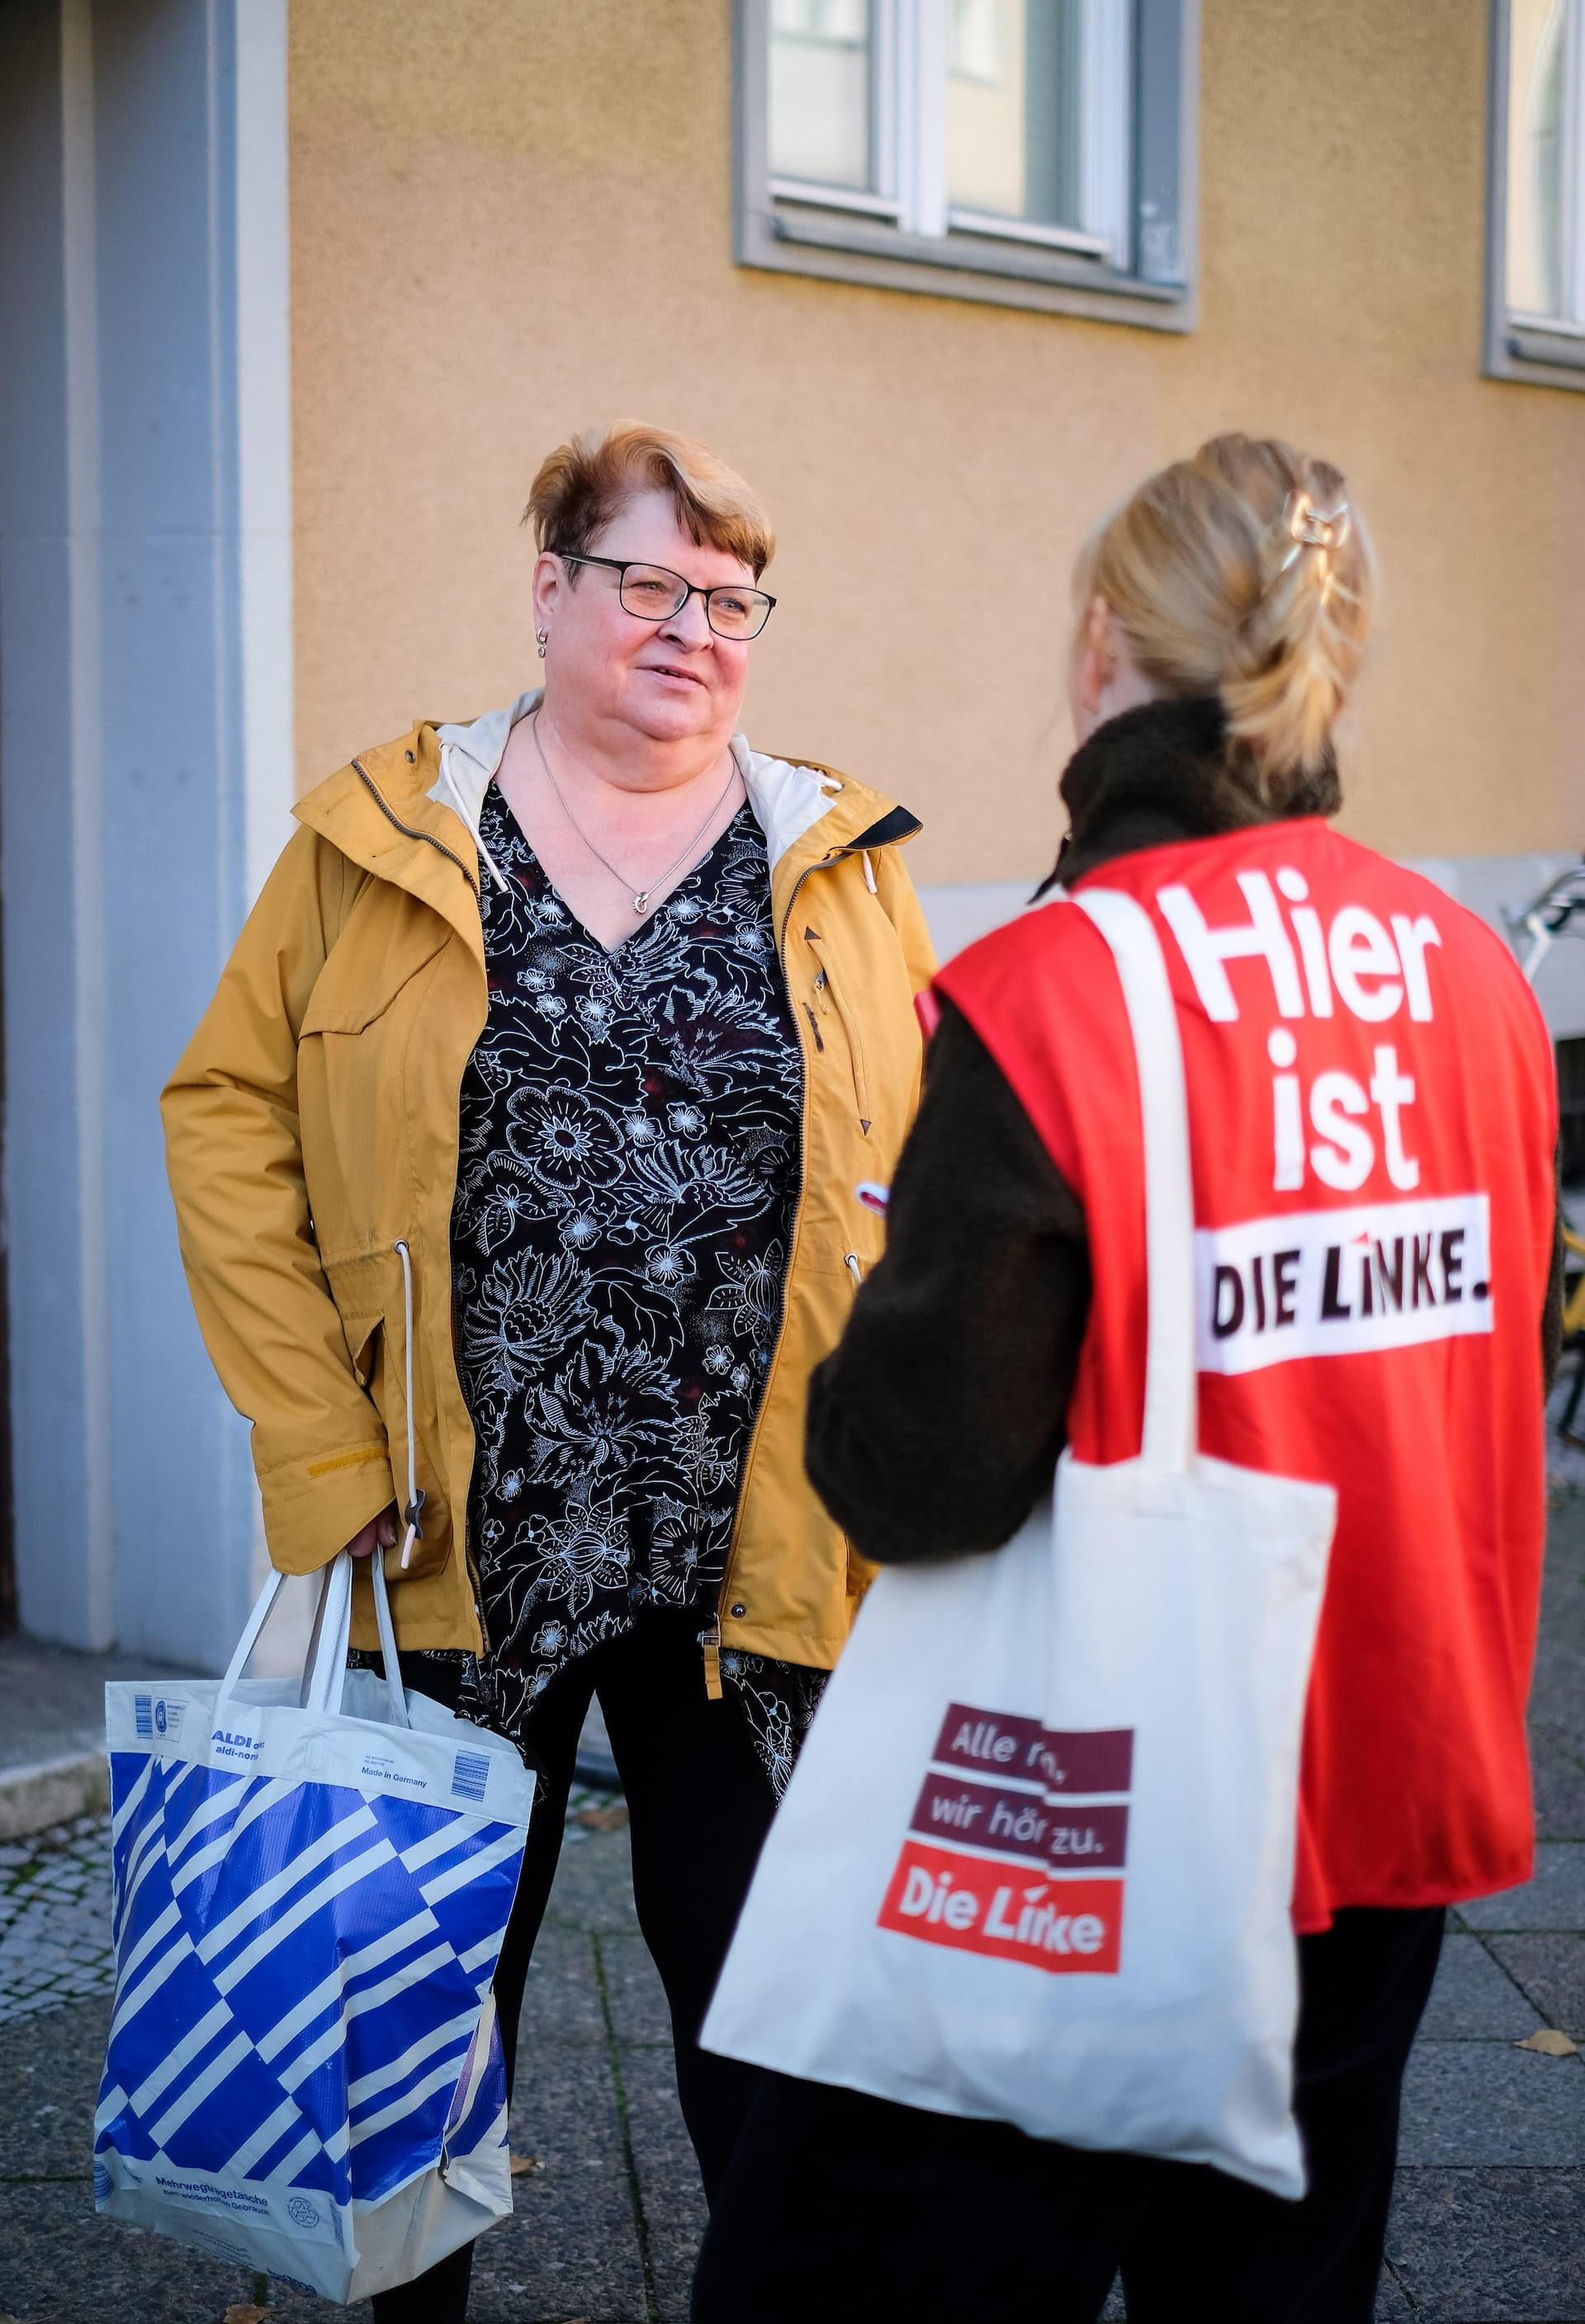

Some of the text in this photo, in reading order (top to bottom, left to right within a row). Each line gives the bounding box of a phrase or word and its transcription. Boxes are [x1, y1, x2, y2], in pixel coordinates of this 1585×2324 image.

[1156, 867, 1441, 1022] Hier
[1268, 1029, 1420, 1191] ist
[1212, 1249, 1301, 1341] DIE
[211, 1730, 253, 1749] ALDI
[951, 1722, 1017, 1763] Alle
[362, 1766, 382, 1778] Made
[393, 1774, 427, 1788] Germany
[931, 1793, 1105, 1855] wir hör zu.
[898, 1864, 979, 1931] Die
